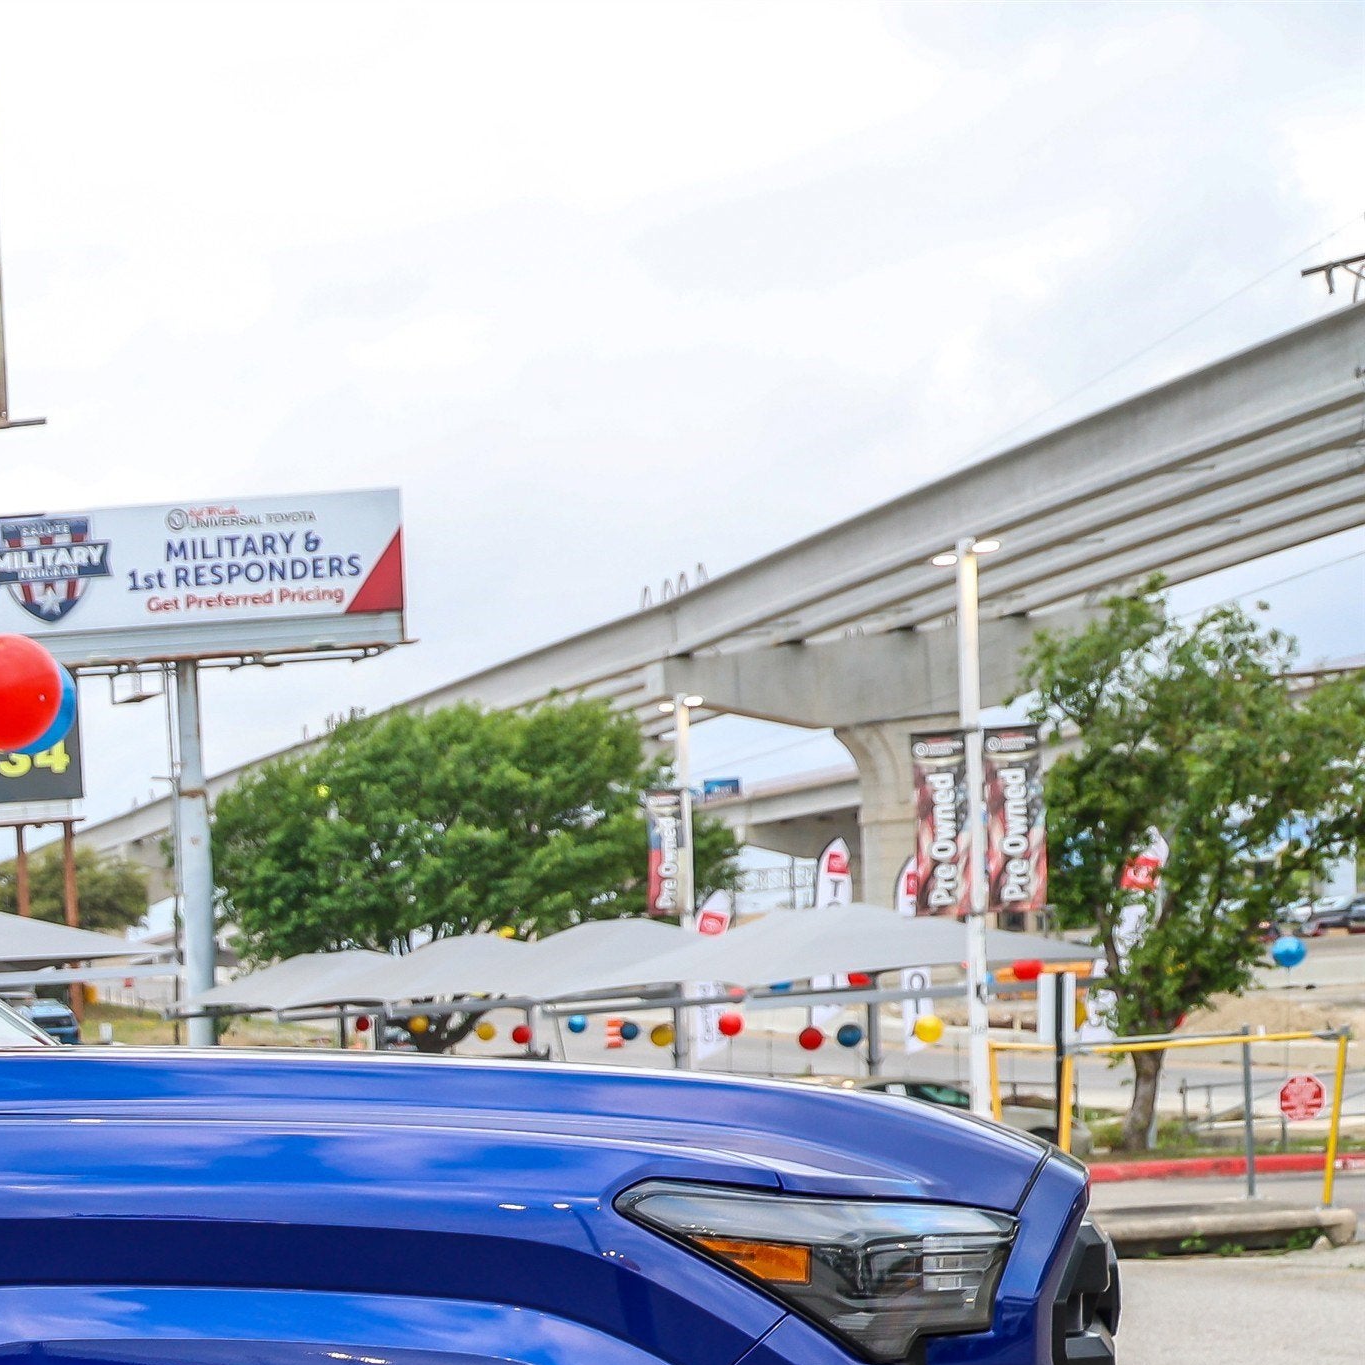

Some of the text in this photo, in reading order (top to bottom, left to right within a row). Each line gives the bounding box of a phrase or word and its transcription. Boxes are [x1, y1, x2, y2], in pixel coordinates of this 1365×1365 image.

[191, 511, 317, 529] UNIVERSAL TOYOTA
[166, 530, 321, 561] MILITARY &
[128, 554, 362, 591] 1st RESPONDERS
[147, 587, 345, 611] Get Preferred Pricing
[925, 773, 957, 860] Owned
[997, 768, 1029, 856] Owned
[928, 863, 958, 906] Pre
[1001, 859, 1029, 900] Pre
